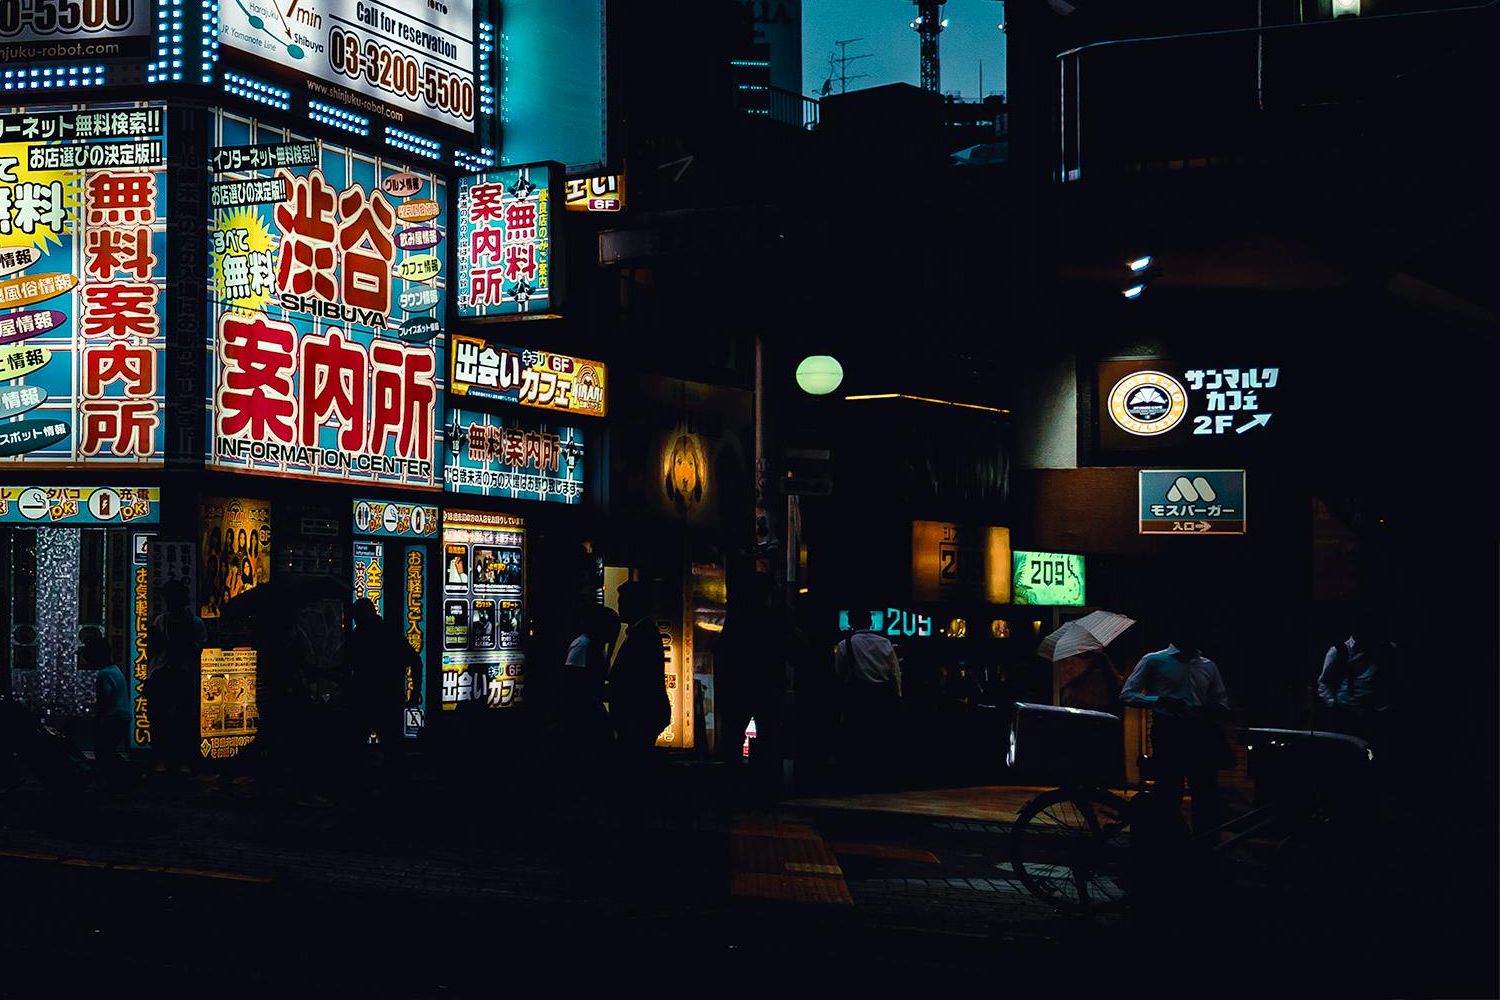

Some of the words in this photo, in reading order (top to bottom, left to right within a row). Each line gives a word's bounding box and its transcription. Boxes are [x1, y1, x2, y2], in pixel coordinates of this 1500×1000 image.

[249, 1, 280, 22] Harajuku
[296, 6, 323, 31] min
[293, 33, 324, 54] Shibuya
[356, 1, 379, 25] Call
[380, 11, 396, 33] for
[399, 20, 458, 61] reservation
[329, 29, 475, 120] 03-3200-5500
[306, 78, 404, 123] www.shinjuku-robot.com
[28, 142, 161, 171] お店選びの決定版!!
[211, 178, 287, 207] お店選びの決定版!!
[213, 229, 249, 255] すべて
[275, 170, 396, 313] 渋谷
[469, 183, 503, 306] 案内所
[505, 204, 538, 282] 無料
[223, 250, 280, 299] 無料
[82, 170, 158, 458] 無料案内所
[280, 293, 388, 330] SHIBUYA
[455, 341, 520, 390] 出会い
[522, 350, 546, 367] キラリ
[553, 356, 570, 372] 6F
[219, 315, 438, 460] 案内所
[519, 368, 572, 407] カフェ
[1184, 367, 1280, 390] サンマルク
[1206, 391, 1259, 412] カフェ
[1192, 415, 1235, 435] 2F
[217, 435, 351, 469] INFORMATION
[358, 454, 431, 477] CENTER
[467, 422, 561, 473] 無料案内所
[45, 488, 81, 499] タバコ
[119, 487, 150, 500] 充電
[50, 501, 77, 518] OK
[121, 501, 147, 518] OK
[1150, 504, 1236, 518] モスバーガー
[1172, 520, 1196, 532] 入口
[1030, 560, 1065, 586] 209
[442, 671, 488, 703] 出会い
